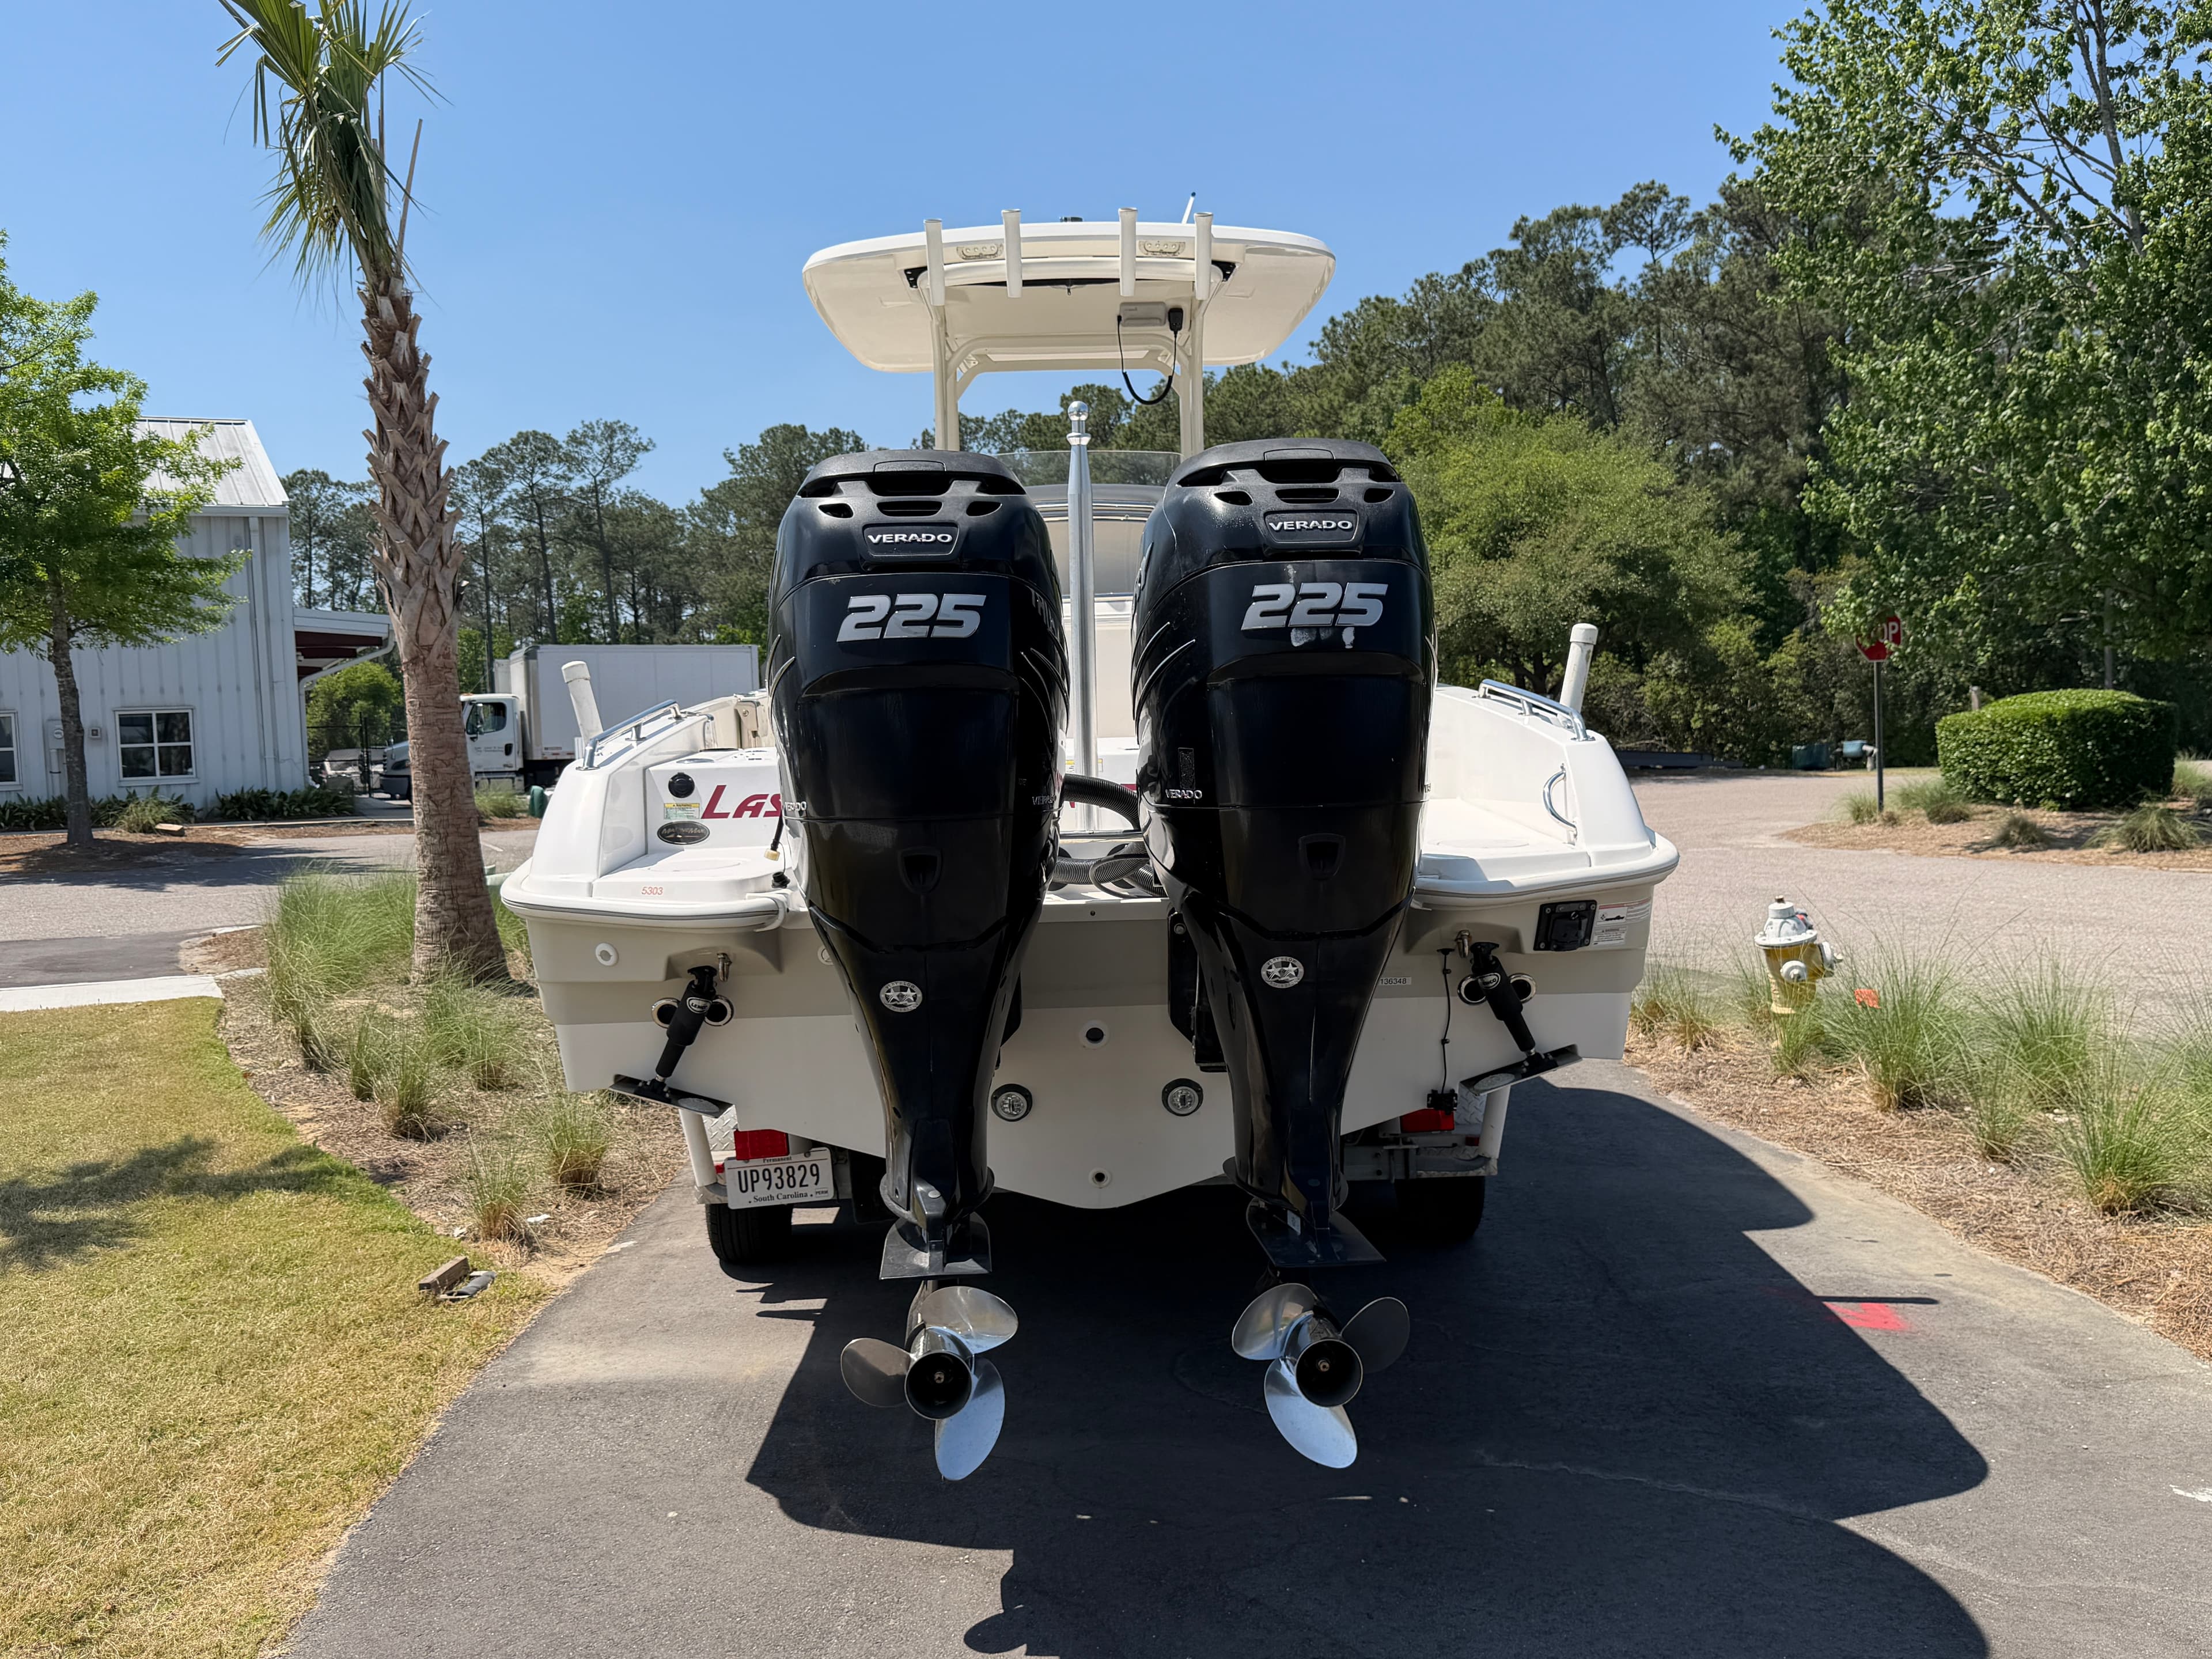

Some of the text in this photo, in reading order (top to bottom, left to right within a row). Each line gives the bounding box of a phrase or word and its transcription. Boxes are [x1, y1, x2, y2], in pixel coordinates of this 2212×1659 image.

[1269, 520, 1354, 532] VERADO
[868, 533, 953, 545] VERADO
[1241, 582, 1389, 631] 225
[836, 593, 987, 642] 225
[1165, 789, 1202, 800] VERADO
[641, 886, 664, 895] 5303
[738, 1163, 820, 1194] UP93829
[753, 1191, 808, 1203] South Carolina
